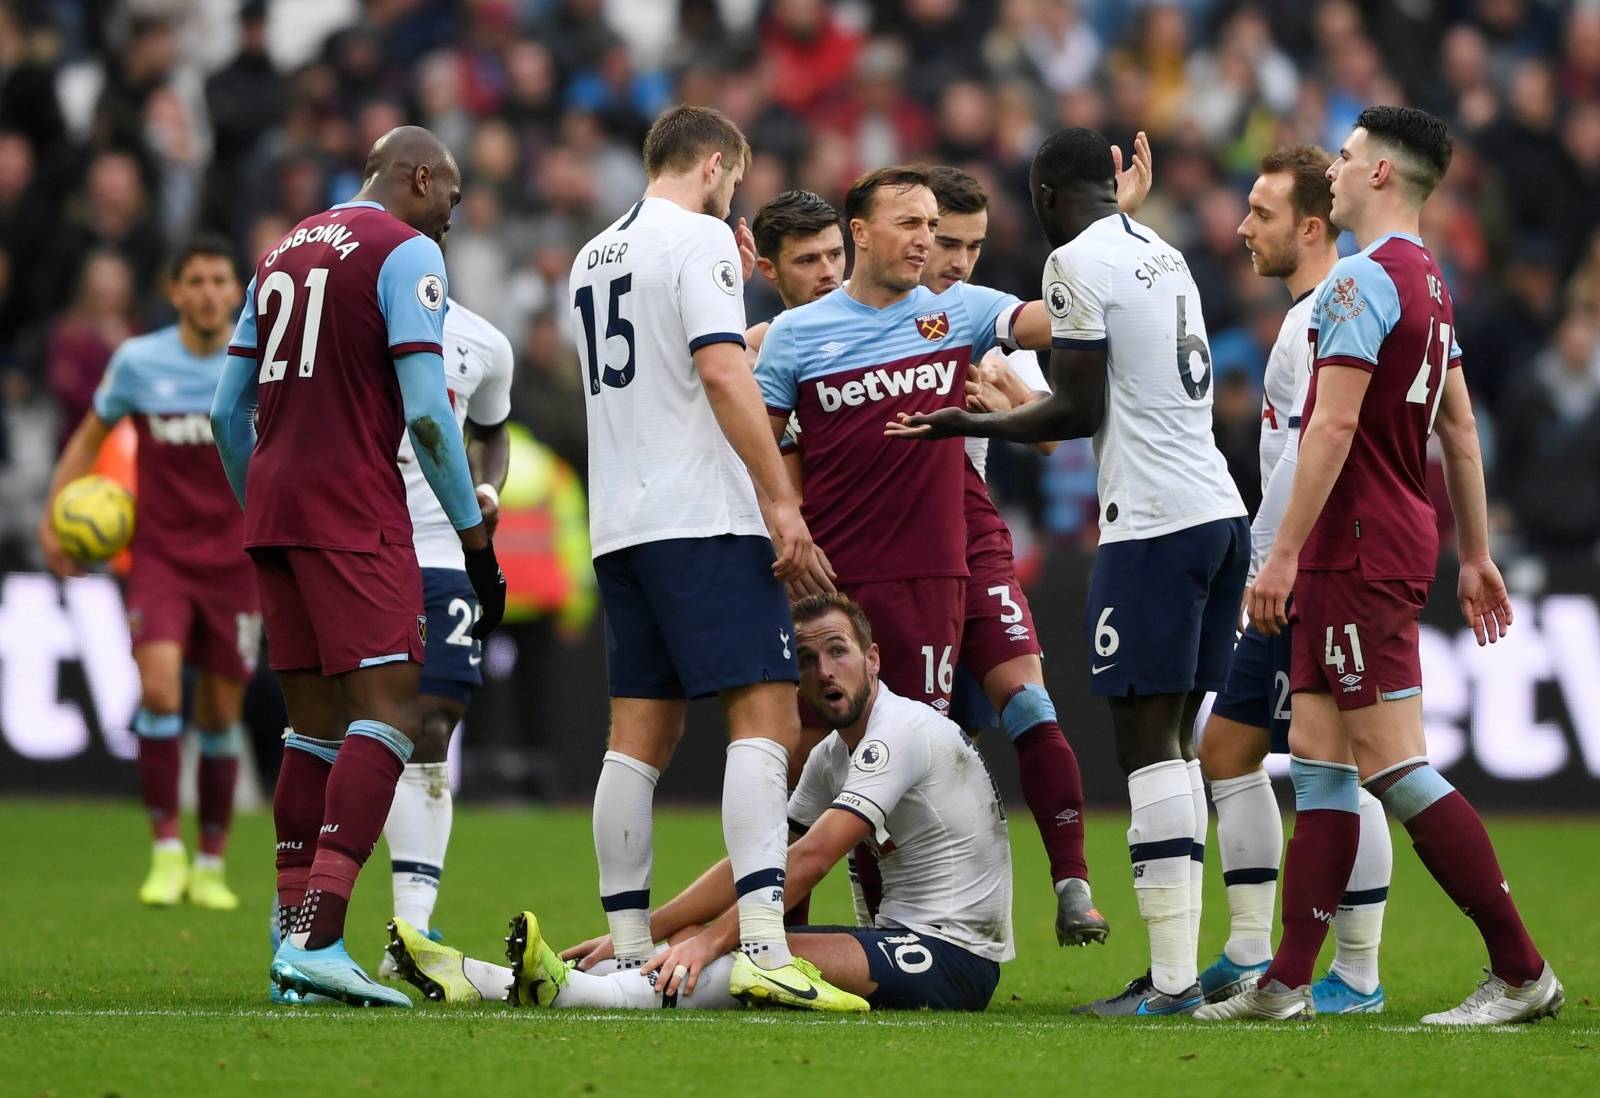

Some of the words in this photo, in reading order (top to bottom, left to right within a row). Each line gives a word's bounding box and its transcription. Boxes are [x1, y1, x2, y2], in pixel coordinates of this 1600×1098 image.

[265, 224, 360, 267] OGBONNA
[587, 242, 629, 271] DIER
[257, 268, 330, 384] 21
[574, 272, 636, 396] 15
[1347, 300, 1366, 320] GOLD
[1176, 295, 1212, 401] 6
[816, 360, 958, 413] betway
[446, 597, 483, 647] 2
[987, 585, 1024, 624] 3
[1094, 607, 1120, 657] 6
[1325, 623, 1365, 674] 41
[921, 645, 954, 694] 16
